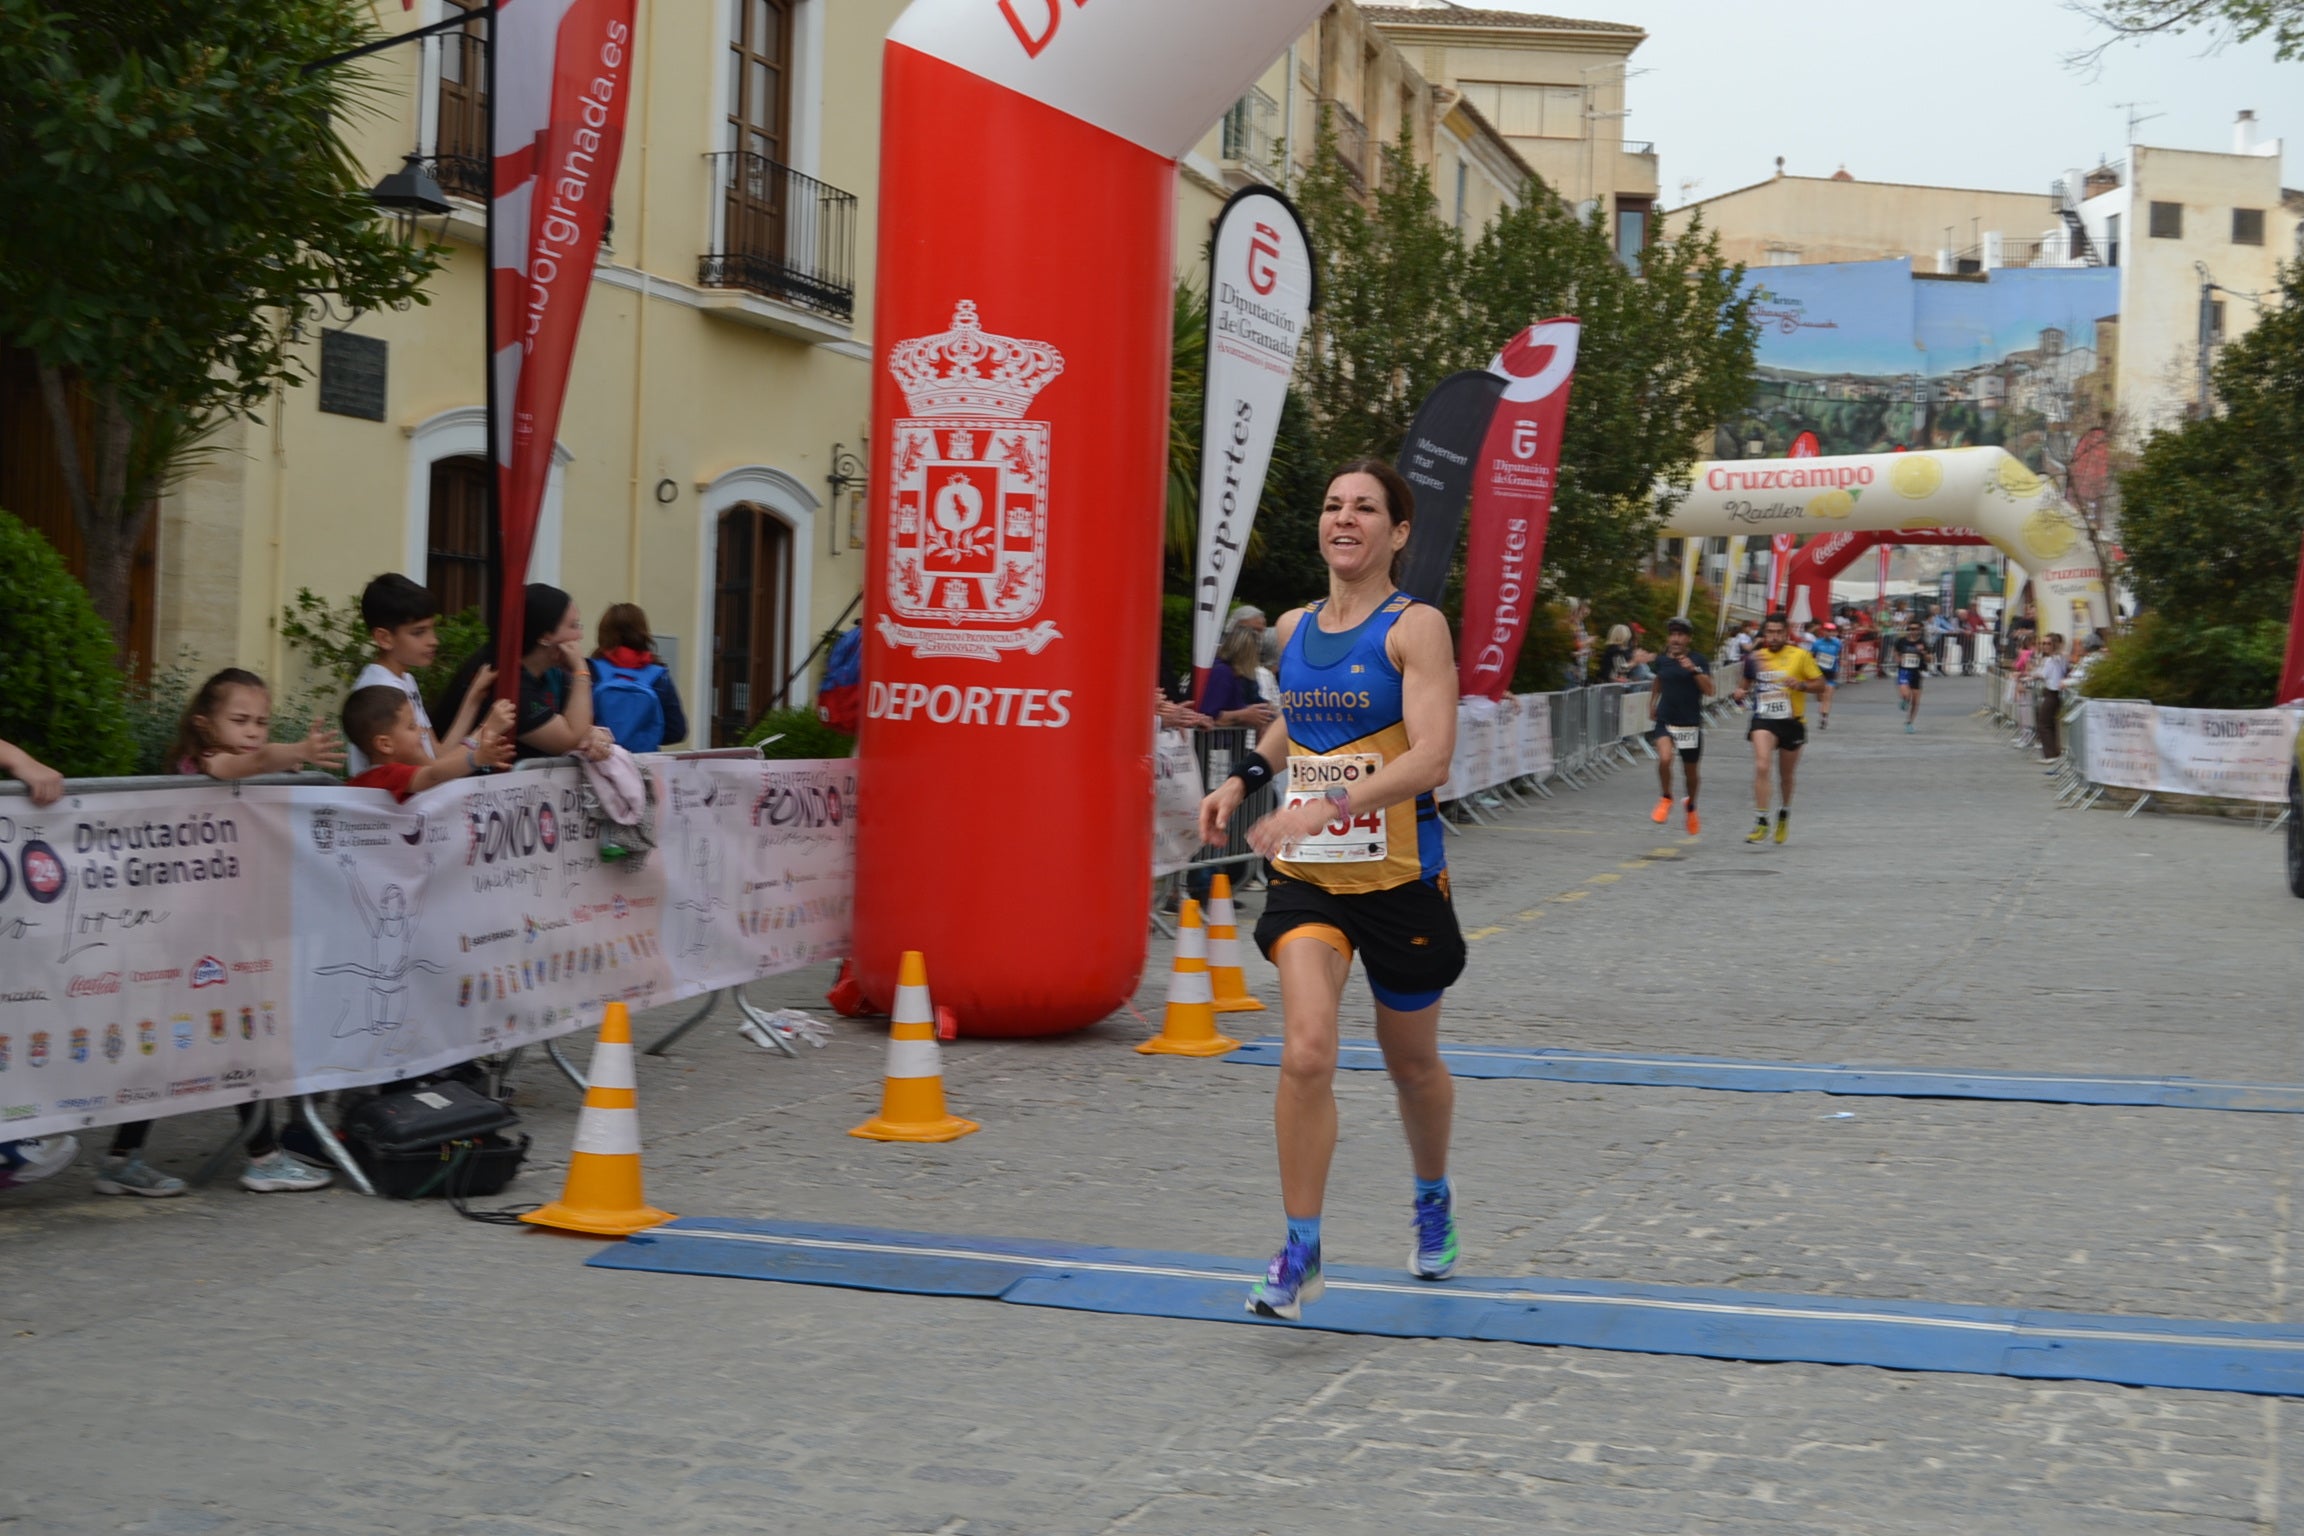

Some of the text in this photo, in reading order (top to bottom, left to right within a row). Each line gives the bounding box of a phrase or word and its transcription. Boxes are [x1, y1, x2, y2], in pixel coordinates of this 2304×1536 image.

[1220, 282, 1296, 333] Diputación
[1217, 310, 1294, 358] de Granada
[1413, 453, 1434, 469] that
[1416, 437, 1468, 466] Movement
[1707, 464, 1875, 492] Cruzcampo
[1722, 500, 1804, 524] Radler
[1476, 518, 1528, 675] Deportes
[867, 680, 1073, 728] DEPORTES
[73, 812, 239, 861] Diputación
[82, 849, 240, 890] de Granada
